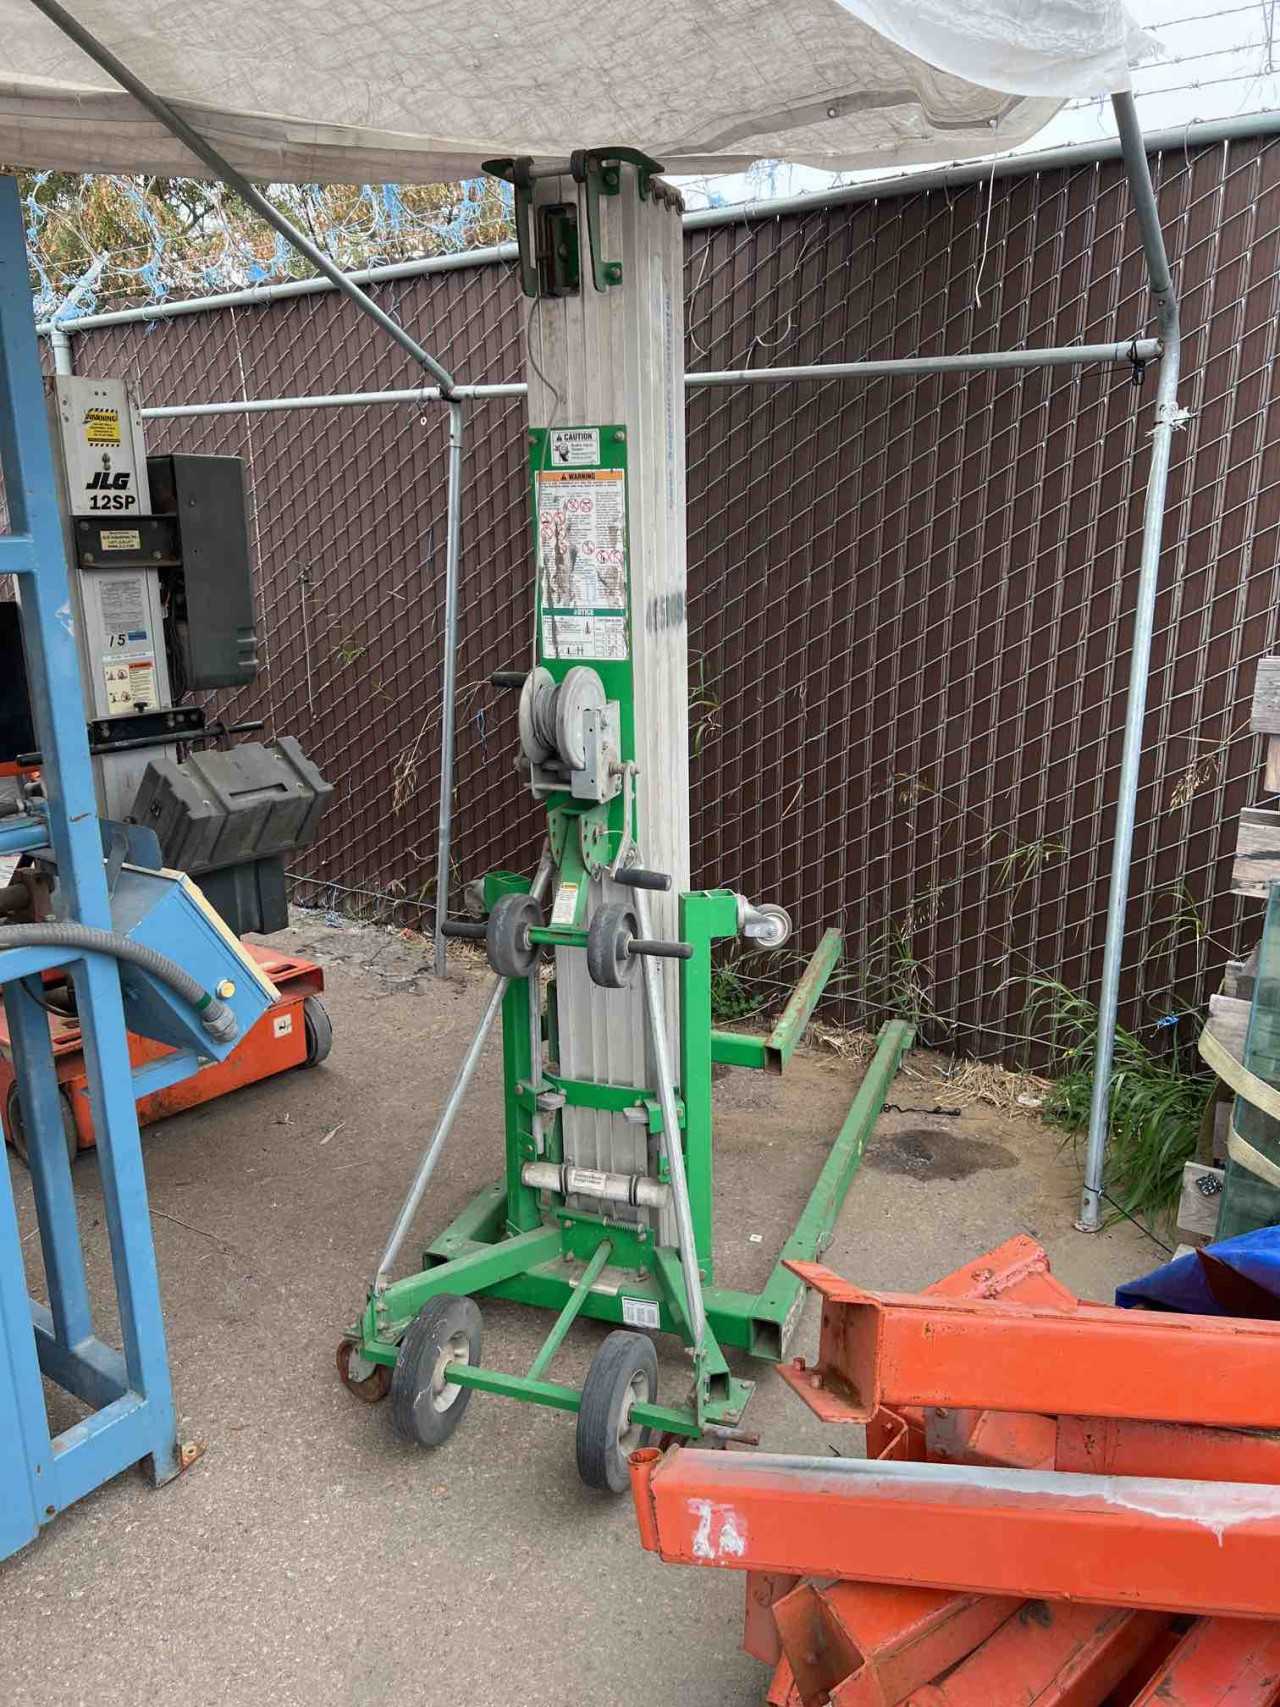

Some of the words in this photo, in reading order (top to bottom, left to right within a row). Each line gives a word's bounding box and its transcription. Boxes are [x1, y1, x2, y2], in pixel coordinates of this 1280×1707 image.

[563, 432, 593, 441] CAUTION
[85, 471, 130, 490] JLG
[568, 472, 596, 480] WARNING
[89, 494, 136, 510] 12SP
